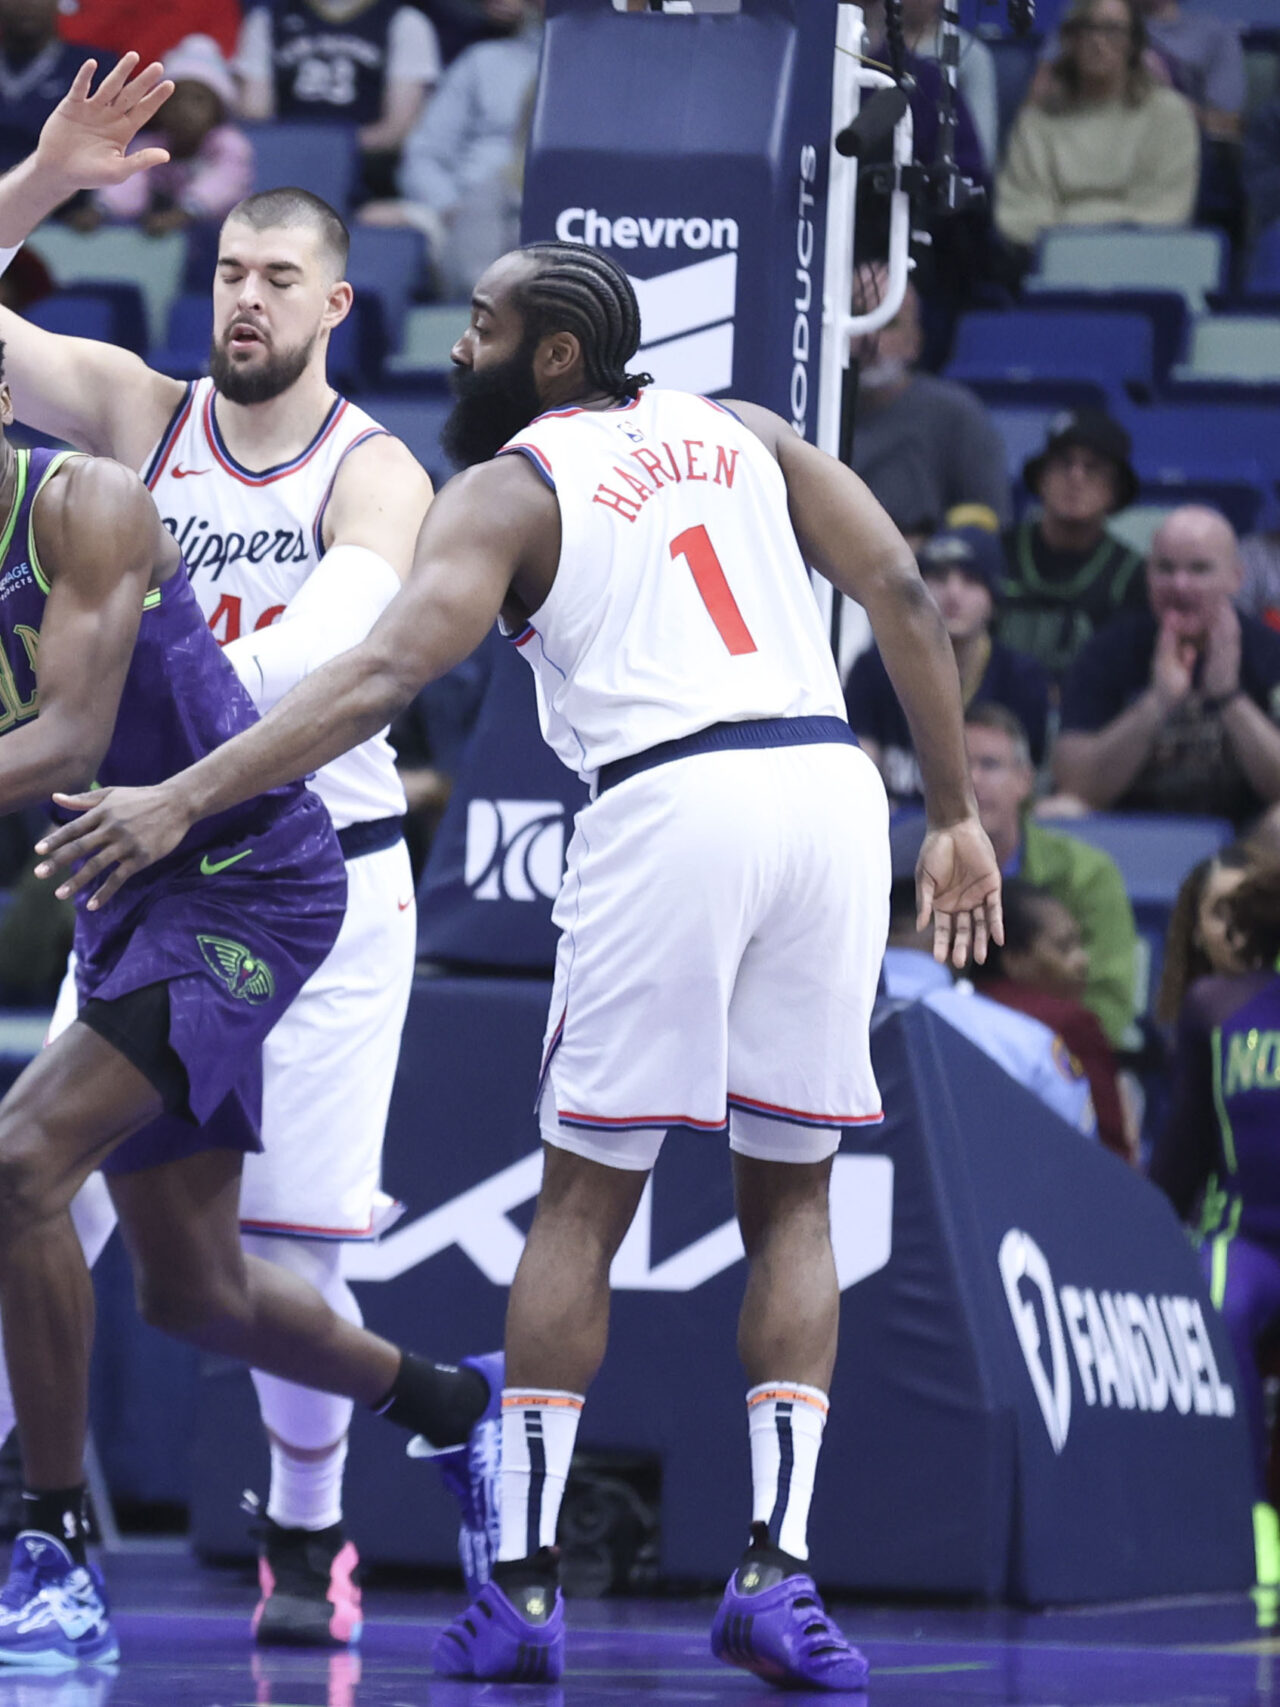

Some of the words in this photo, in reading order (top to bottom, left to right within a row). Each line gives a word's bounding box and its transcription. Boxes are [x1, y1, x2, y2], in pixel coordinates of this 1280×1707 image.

[556, 207, 739, 250] Chevron
[790, 144, 817, 438] ODUCTS
[207, 593, 288, 648] 4
[669, 523, 759, 657] 1
[1059, 1284, 1236, 1419] FANDUEL
